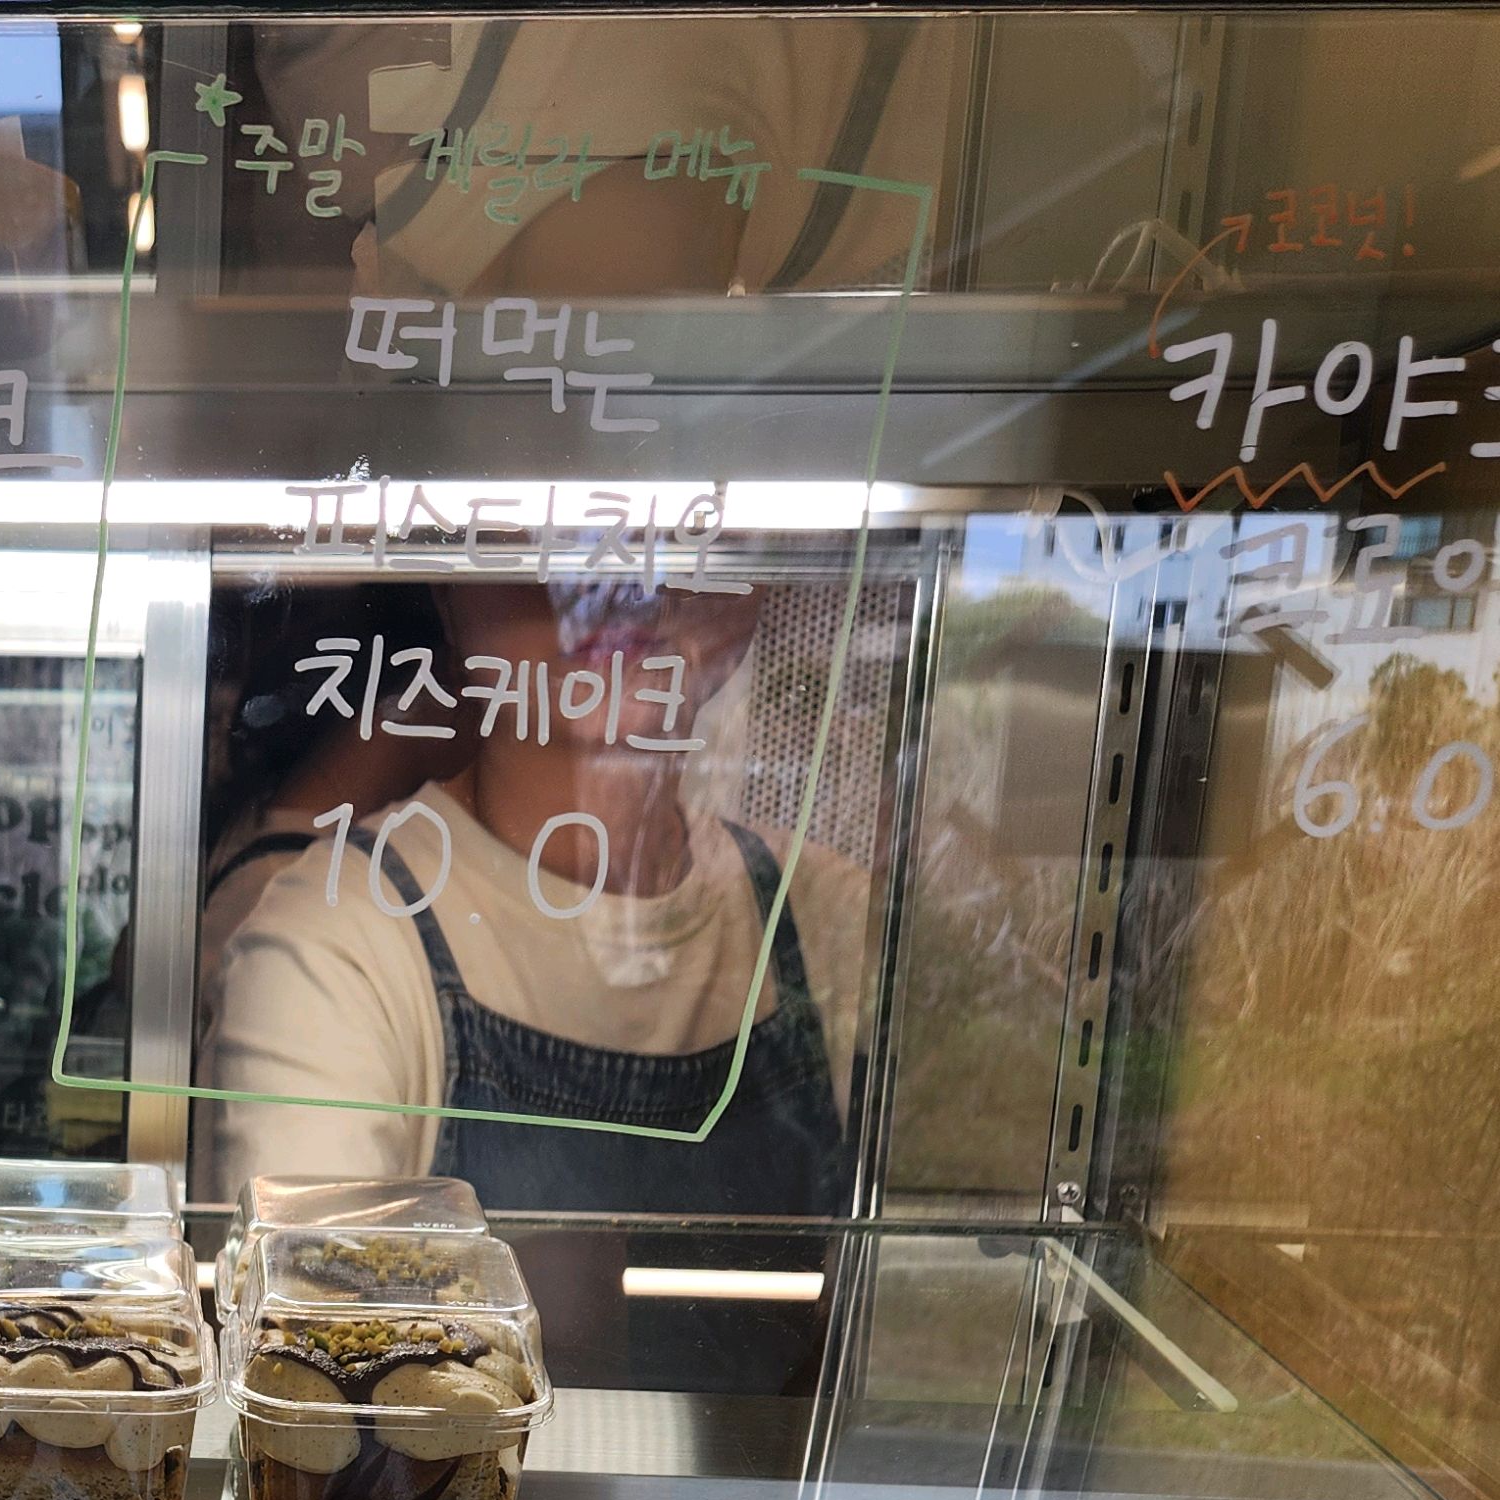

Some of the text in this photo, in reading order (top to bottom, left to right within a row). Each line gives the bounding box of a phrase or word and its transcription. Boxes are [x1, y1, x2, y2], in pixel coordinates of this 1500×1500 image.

[235, 113, 366, 217] 주말
[644, 125, 772, 211] 메뉴
[1266, 183, 1417, 259] 코코넛!
[286, 475, 753, 595] 피스타치오
[295, 634, 705, 750] 치즈케이크
[1293, 713, 1494, 838] 6.0
[313, 802, 608, 924] 10.0
